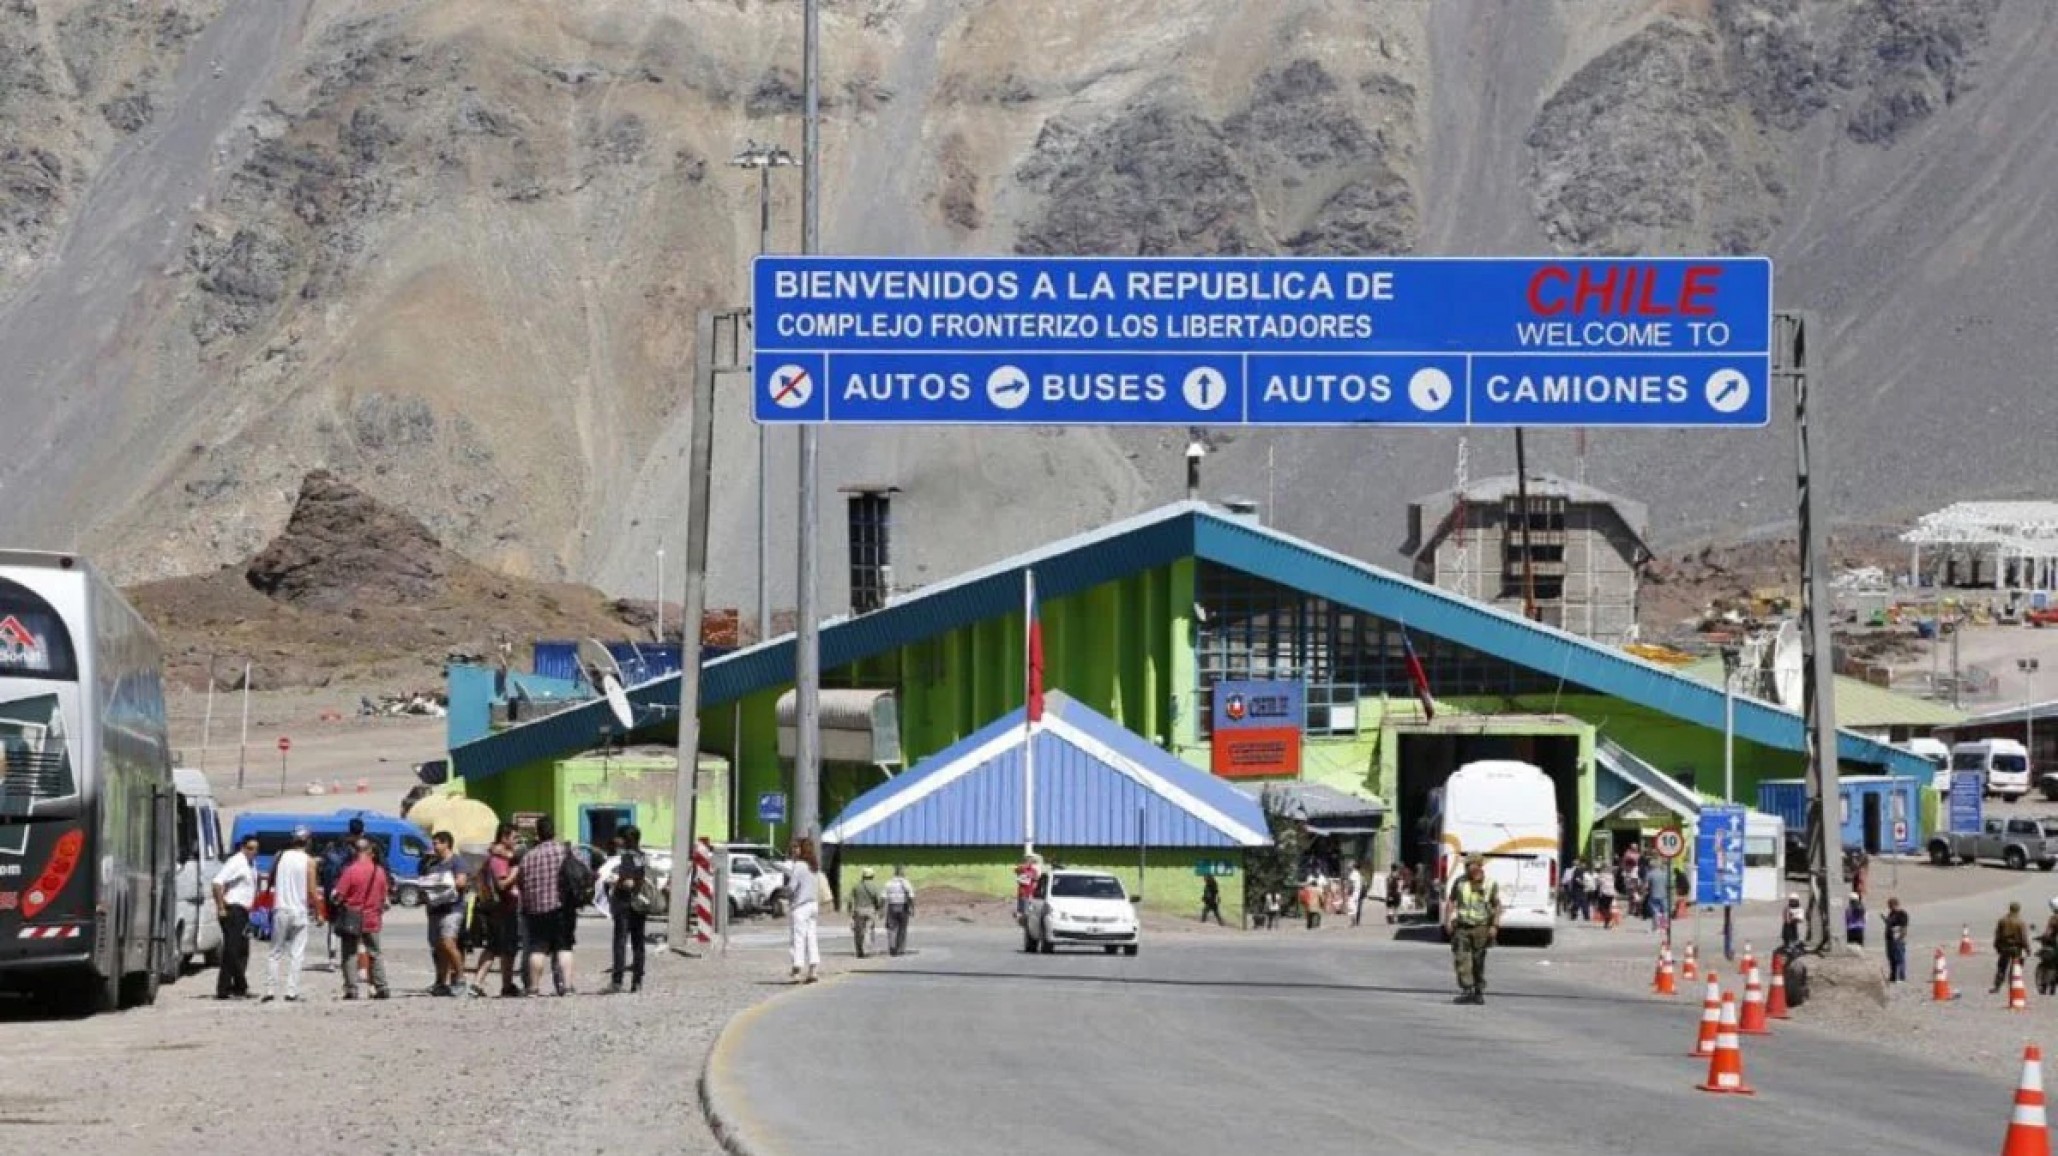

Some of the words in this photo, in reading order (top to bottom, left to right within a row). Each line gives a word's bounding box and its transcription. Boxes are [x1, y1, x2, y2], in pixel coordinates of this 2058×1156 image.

[775, 271, 1018, 299] BIENVENIDOS
[1032, 272, 1056, 298] A
[1069, 272, 1114, 298] LA
[1128, 272, 1334, 299] REPUBLICA
[1347, 272, 1393, 299] DE
[1526, 265, 1722, 316] CHILE
[777, 313, 922, 337] COMPLEJO
[931, 314, 1098, 337] FRONTERIZO
[1107, 315, 1158, 337] LOS
[1167, 315, 1371, 338] LIBERTADORES
[1517, 322, 1671, 346] WELCOME
[1690, 323, 1729, 346] TO
[844, 373, 970, 400] AUTOS
[1043, 373, 1165, 401] BUSES
[1263, 375, 1391, 402] AUTOS
[1487, 375, 1687, 402] CAMIONES
[1662, 835, 1677, 847] 10
